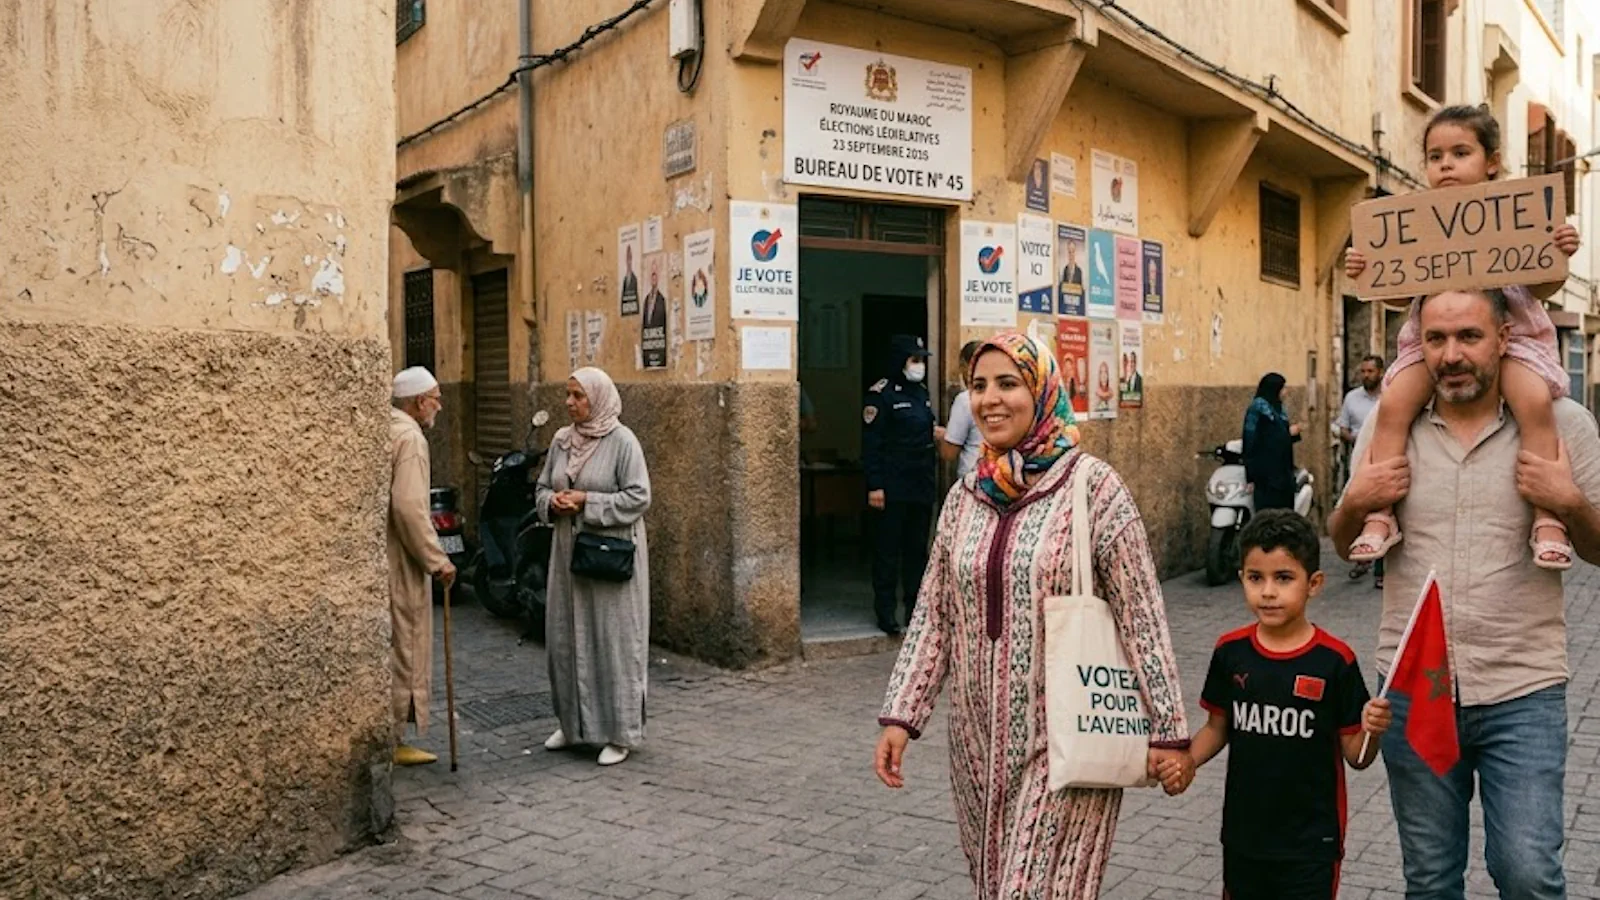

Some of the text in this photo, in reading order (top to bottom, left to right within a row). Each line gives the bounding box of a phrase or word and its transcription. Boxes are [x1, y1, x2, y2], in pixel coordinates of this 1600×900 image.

[830, 103, 878, 120] ROYAUME
[897, 112, 932, 127] MAROC
[820, 116, 874, 137] ÉLECTIONS
[833, 139, 846, 151] 23
[794, 157, 858, 180] BUREAU
[862, 164, 882, 182] DE
[886, 167, 923, 187] VOTE
[946, 175, 964, 191] 45
[1369, 208, 1417, 249] JE
[736, 268, 793, 283] JE VOTE
[1371, 242, 1553, 288] 23 SEPT 2026
[965, 280, 1013, 294] JE VOTE
[1077, 664, 1140, 690] VOTEZ
[1091, 692, 1138, 712] POUR
[1077, 715, 1151, 736] L'AVENIR
[1233, 700, 1315, 739] MAROC
